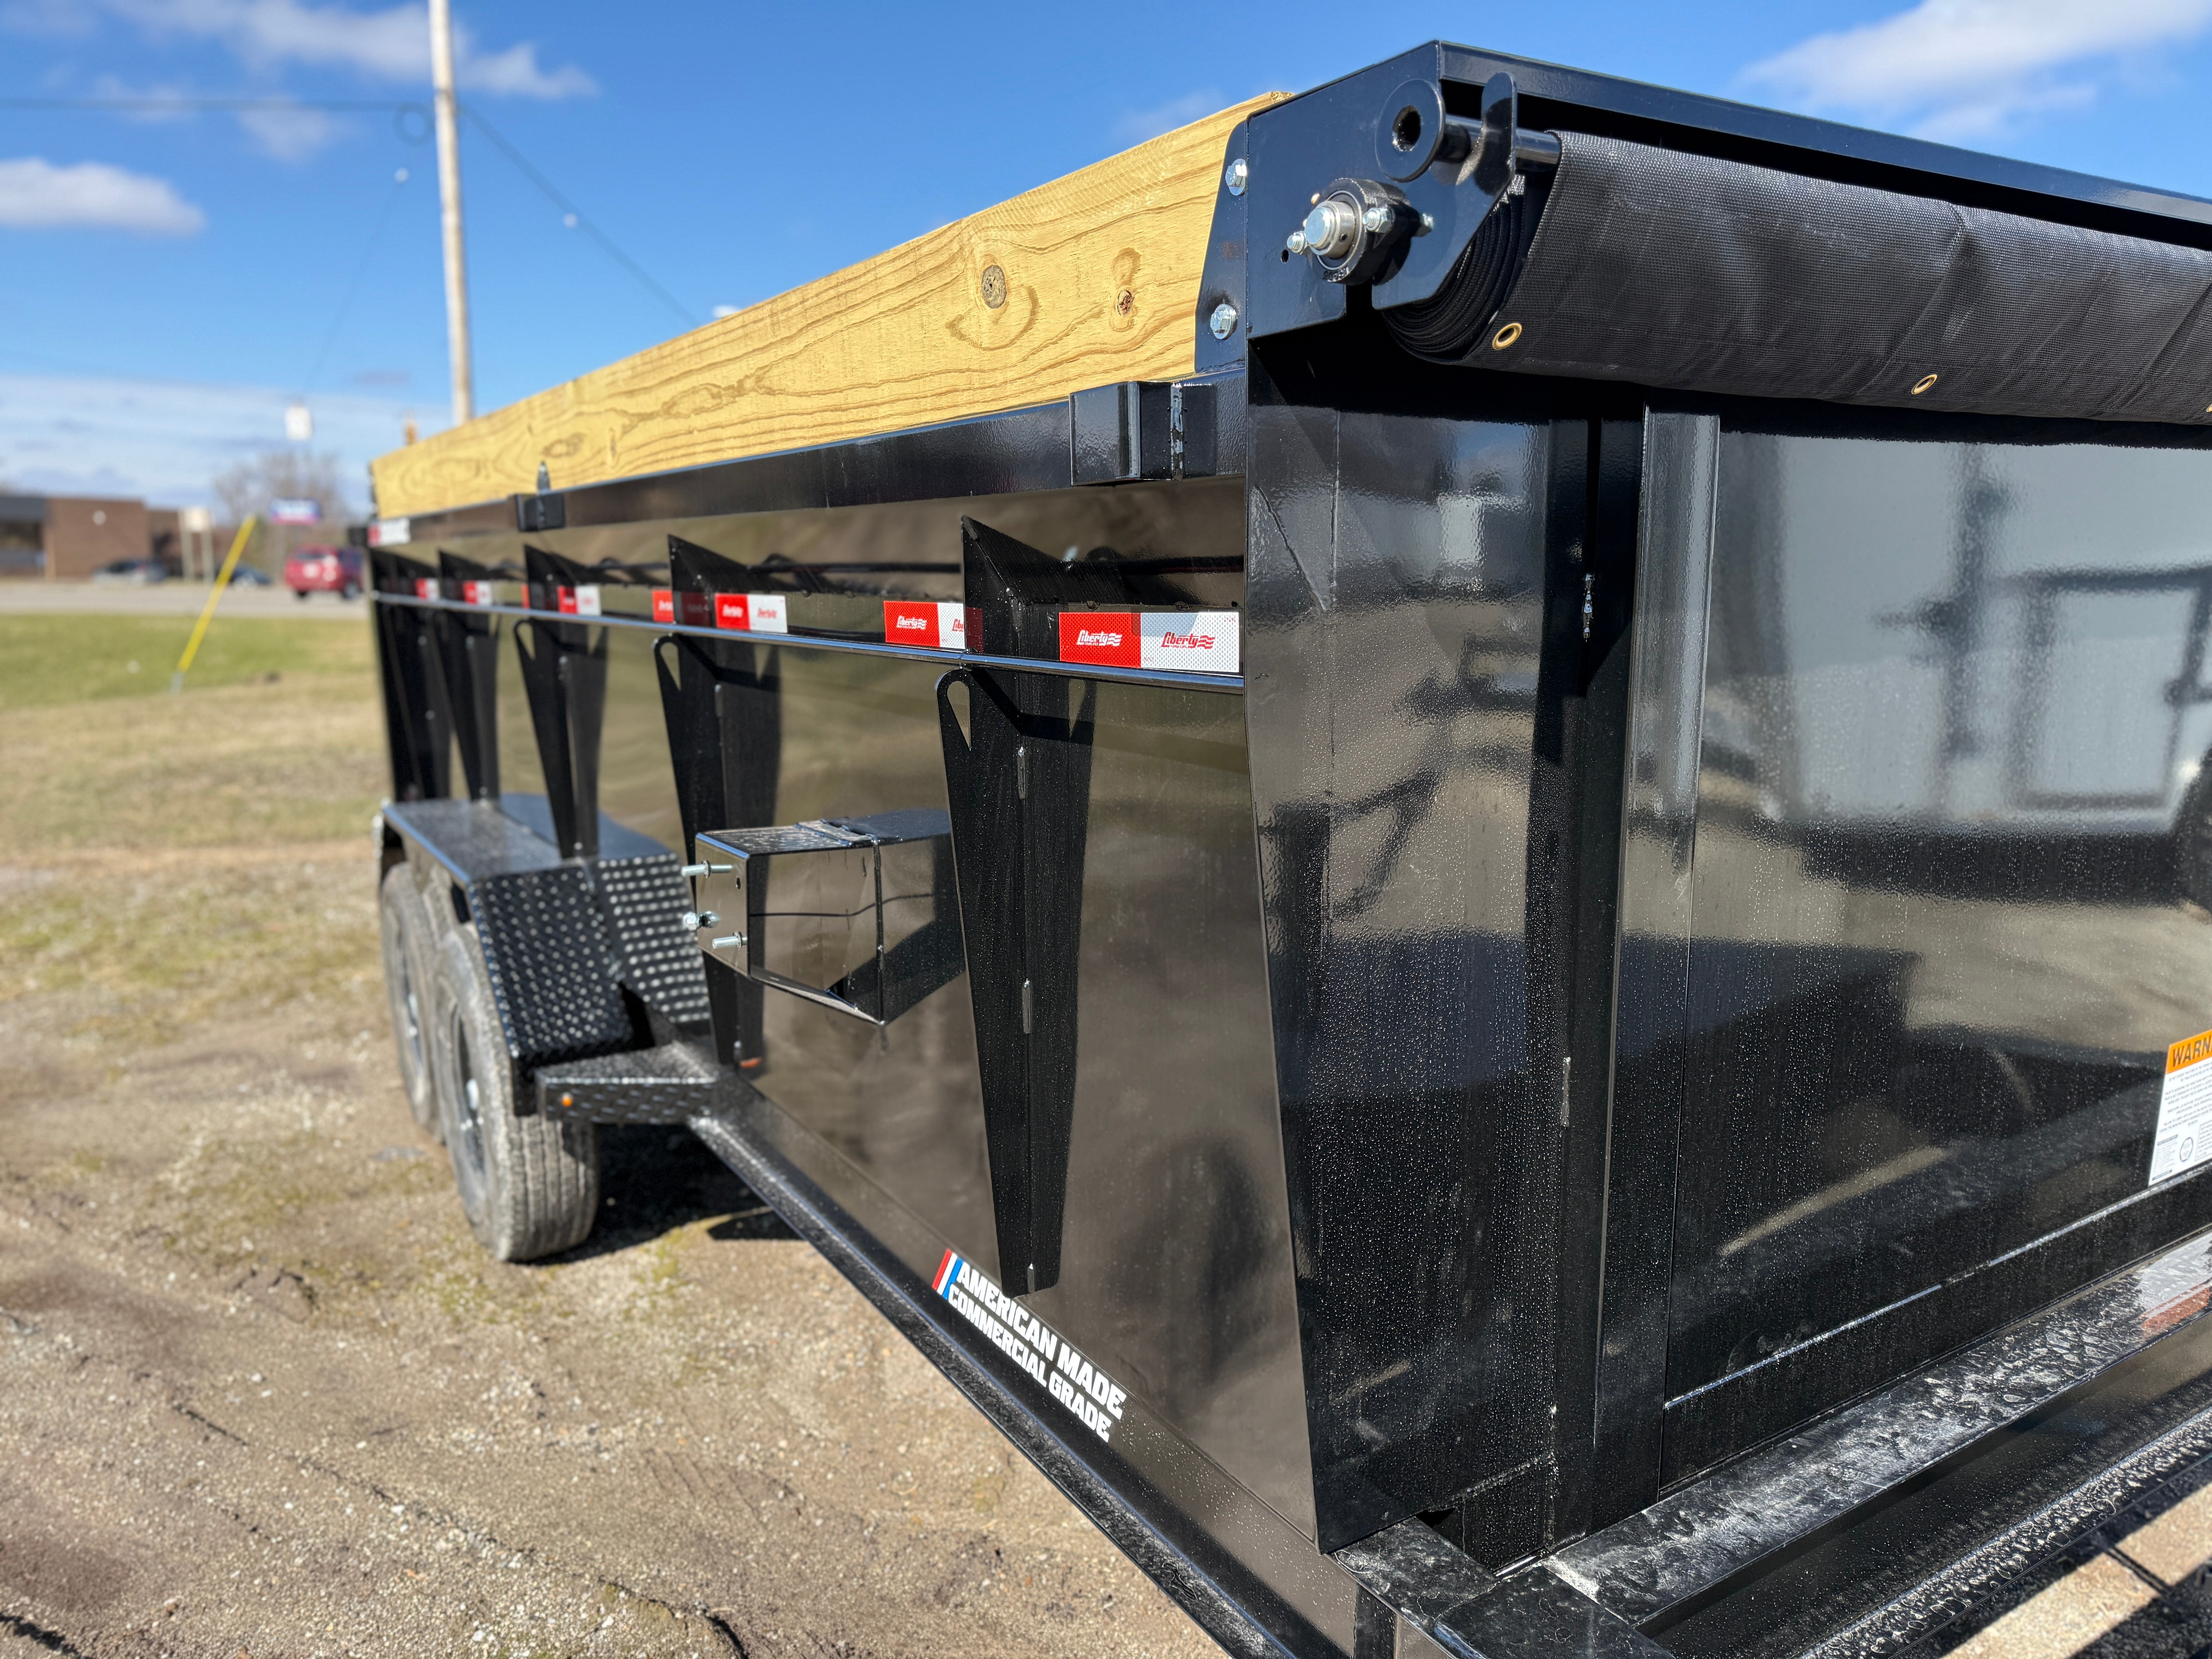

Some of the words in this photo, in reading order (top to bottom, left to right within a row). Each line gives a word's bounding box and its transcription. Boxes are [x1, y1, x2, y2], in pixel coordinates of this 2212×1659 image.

[1076, 630, 1109, 646] Liberty
[1161, 632, 1199, 649] Liberty
[2172, 1035, 2212, 1067] WARN
[957, 1262, 1058, 1362] AMERICAN
[1057, 1343, 1127, 1420] MADE
[948, 1284, 1047, 1388] COMMERCIAL
[1048, 1371, 1112, 1443] GRADE
